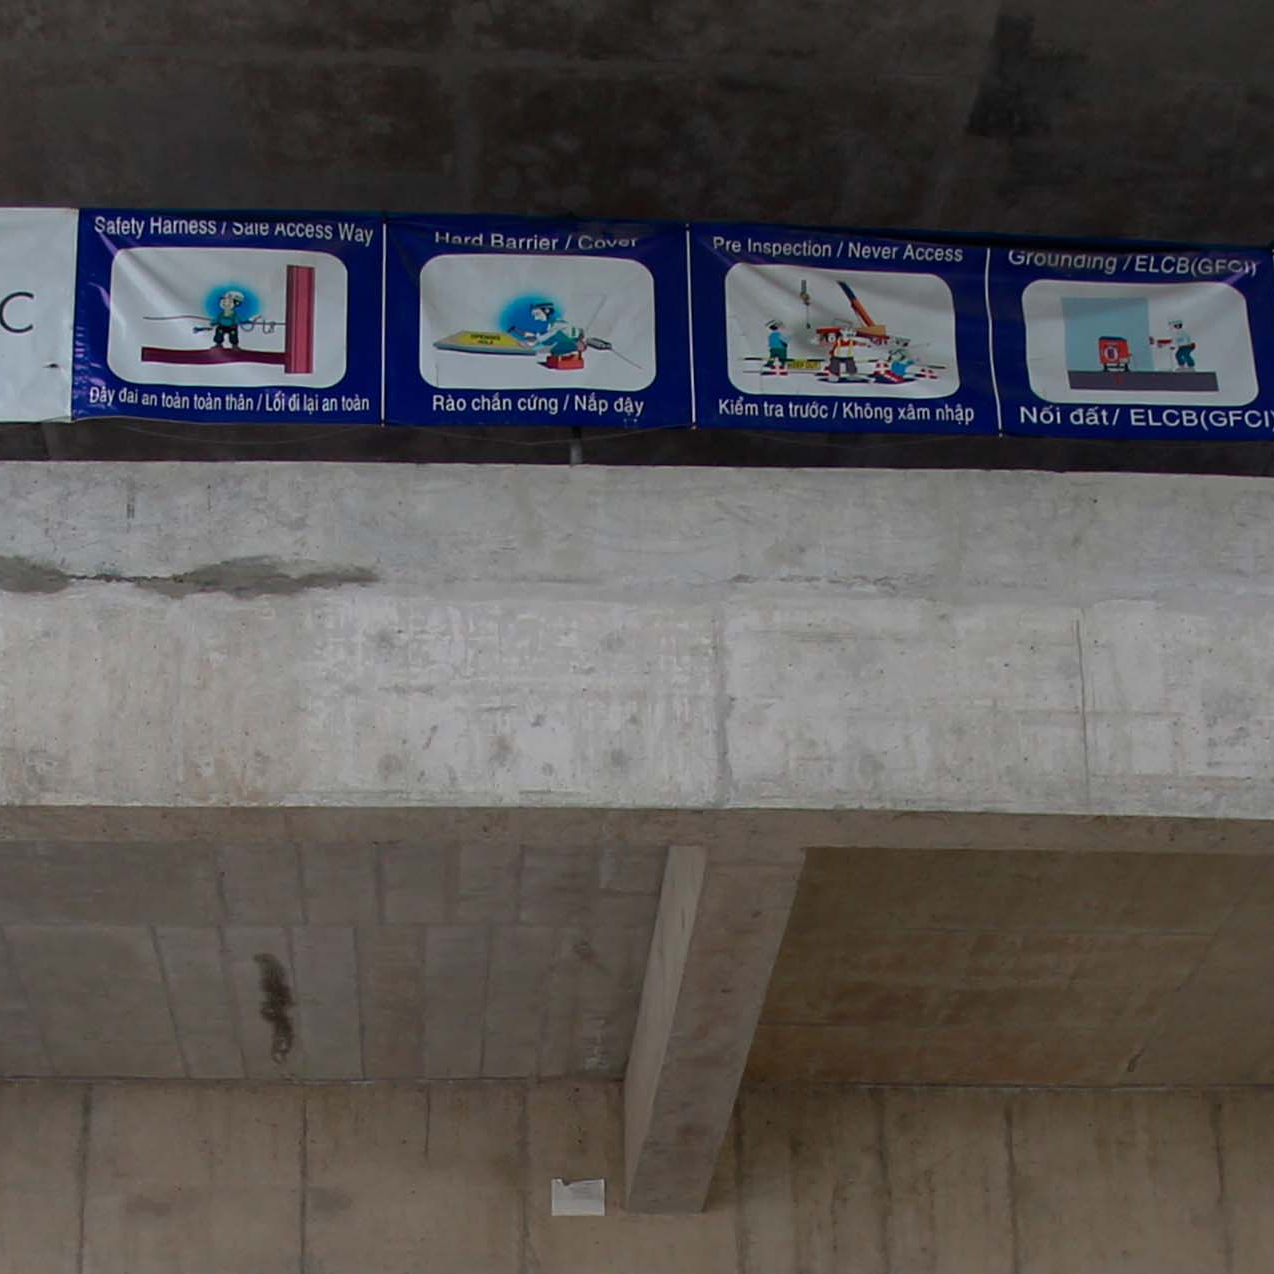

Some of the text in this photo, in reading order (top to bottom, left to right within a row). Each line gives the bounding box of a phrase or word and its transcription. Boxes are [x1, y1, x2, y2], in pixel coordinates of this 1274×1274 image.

[94, 216, 145, 240] Safety
[150, 217, 217, 235] Harness
[274, 222, 333, 241] Access
[338, 223, 373, 246] Way
[434, 231, 637, 250] Hard Barrier / Cover
[713, 236, 964, 262] Pre Inspection / Never Access
[1009, 249, 1118, 276] Grounding
[142, 393, 157, 406] an
[162, 391, 189, 409] toàn
[193, 392, 221, 411] toàn
[225, 393, 254, 411] thân
[257, 394, 263, 411] /
[303, 393, 319, 415] lại
[322, 397, 338, 411] an
[342, 393, 370, 411] toàn
[432, 393, 467, 411] Rào
[517, 394, 558, 415] cứng
[563, 395, 569, 411] /
[763, 402, 784, 417] tra
[789, 401, 828, 419] trước
[832, 402, 838, 419] /
[843, 402, 893, 424] Không
[897, 403, 930, 420] xâm
[935, 403, 975, 425] nhập
[1020, 405, 1062, 425] Nối
